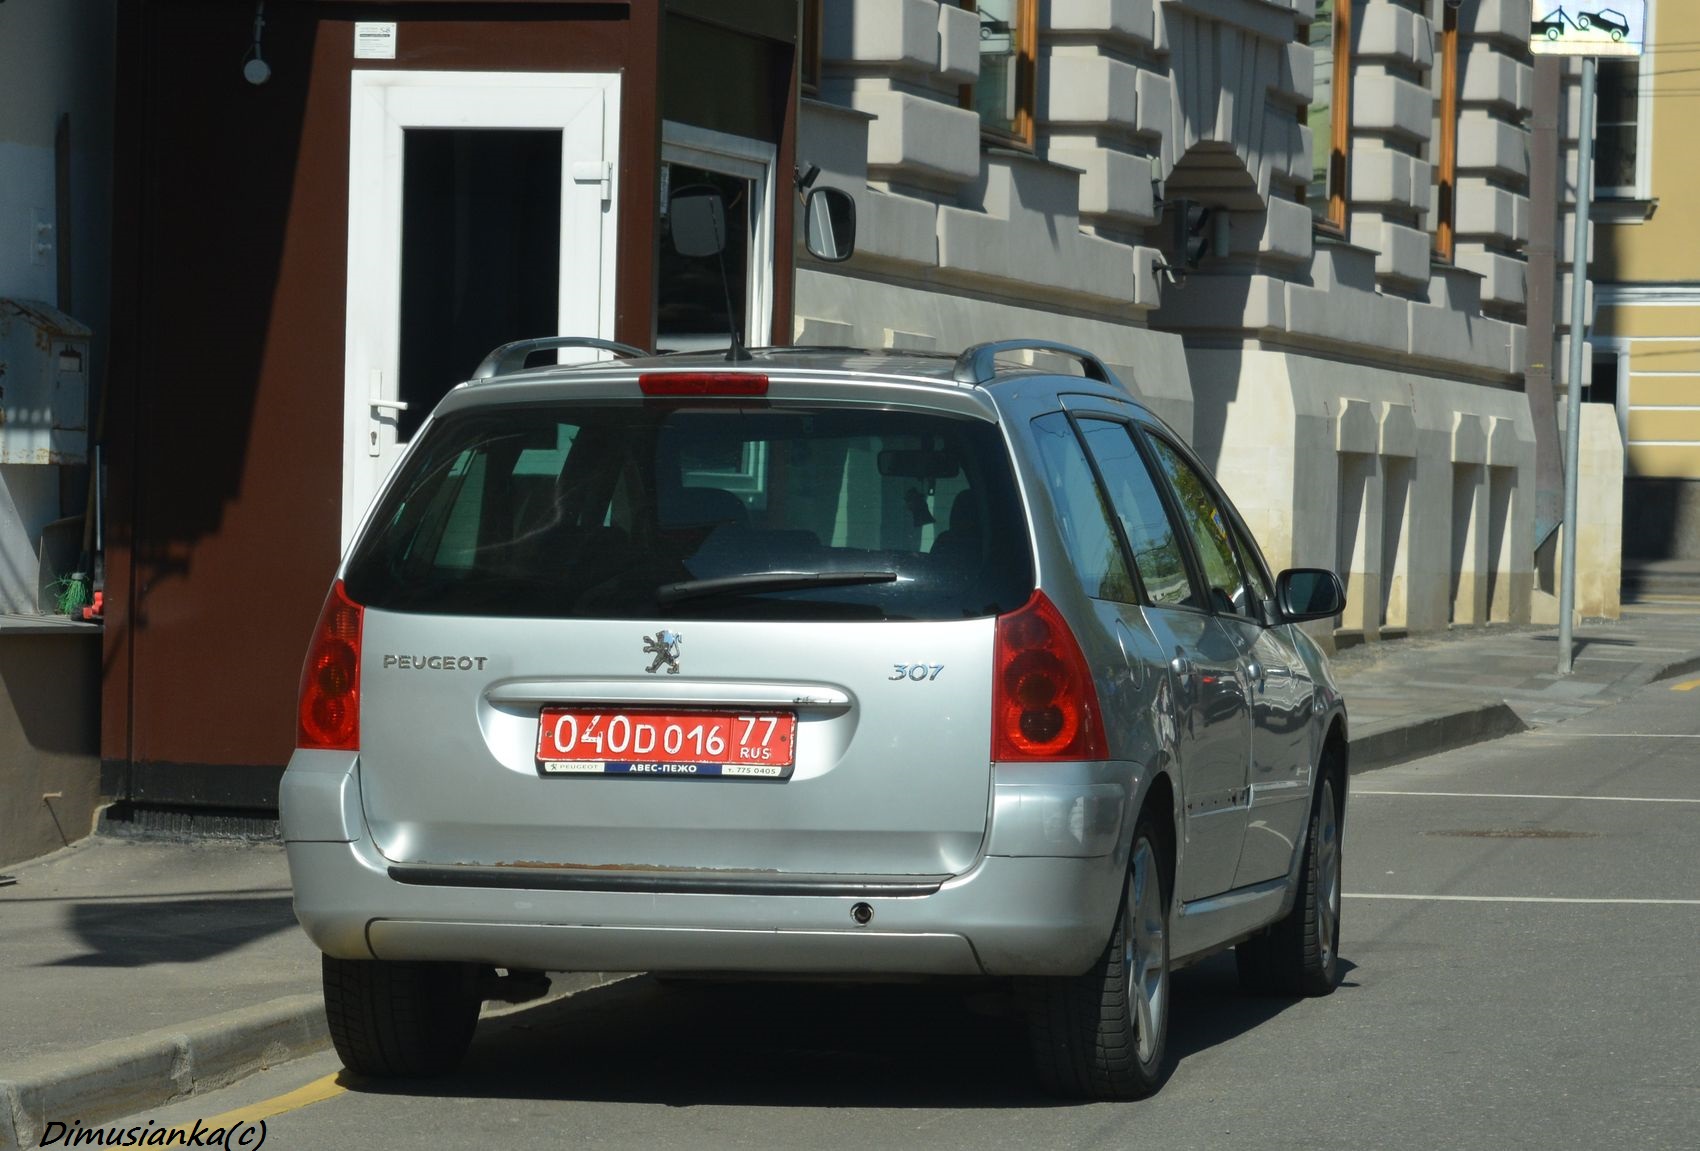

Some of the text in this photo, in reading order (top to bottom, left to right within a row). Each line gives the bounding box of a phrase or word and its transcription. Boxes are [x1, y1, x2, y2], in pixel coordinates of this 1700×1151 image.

[383, 654, 488, 671] PEUGEOT
[888, 664, 944, 682] 307
[738, 716, 779, 747] 77
[740, 747, 771, 760] RUS
[629, 763, 697, 773] АВЕС-ПЕЖО
[736, 766, 752, 774] 775
